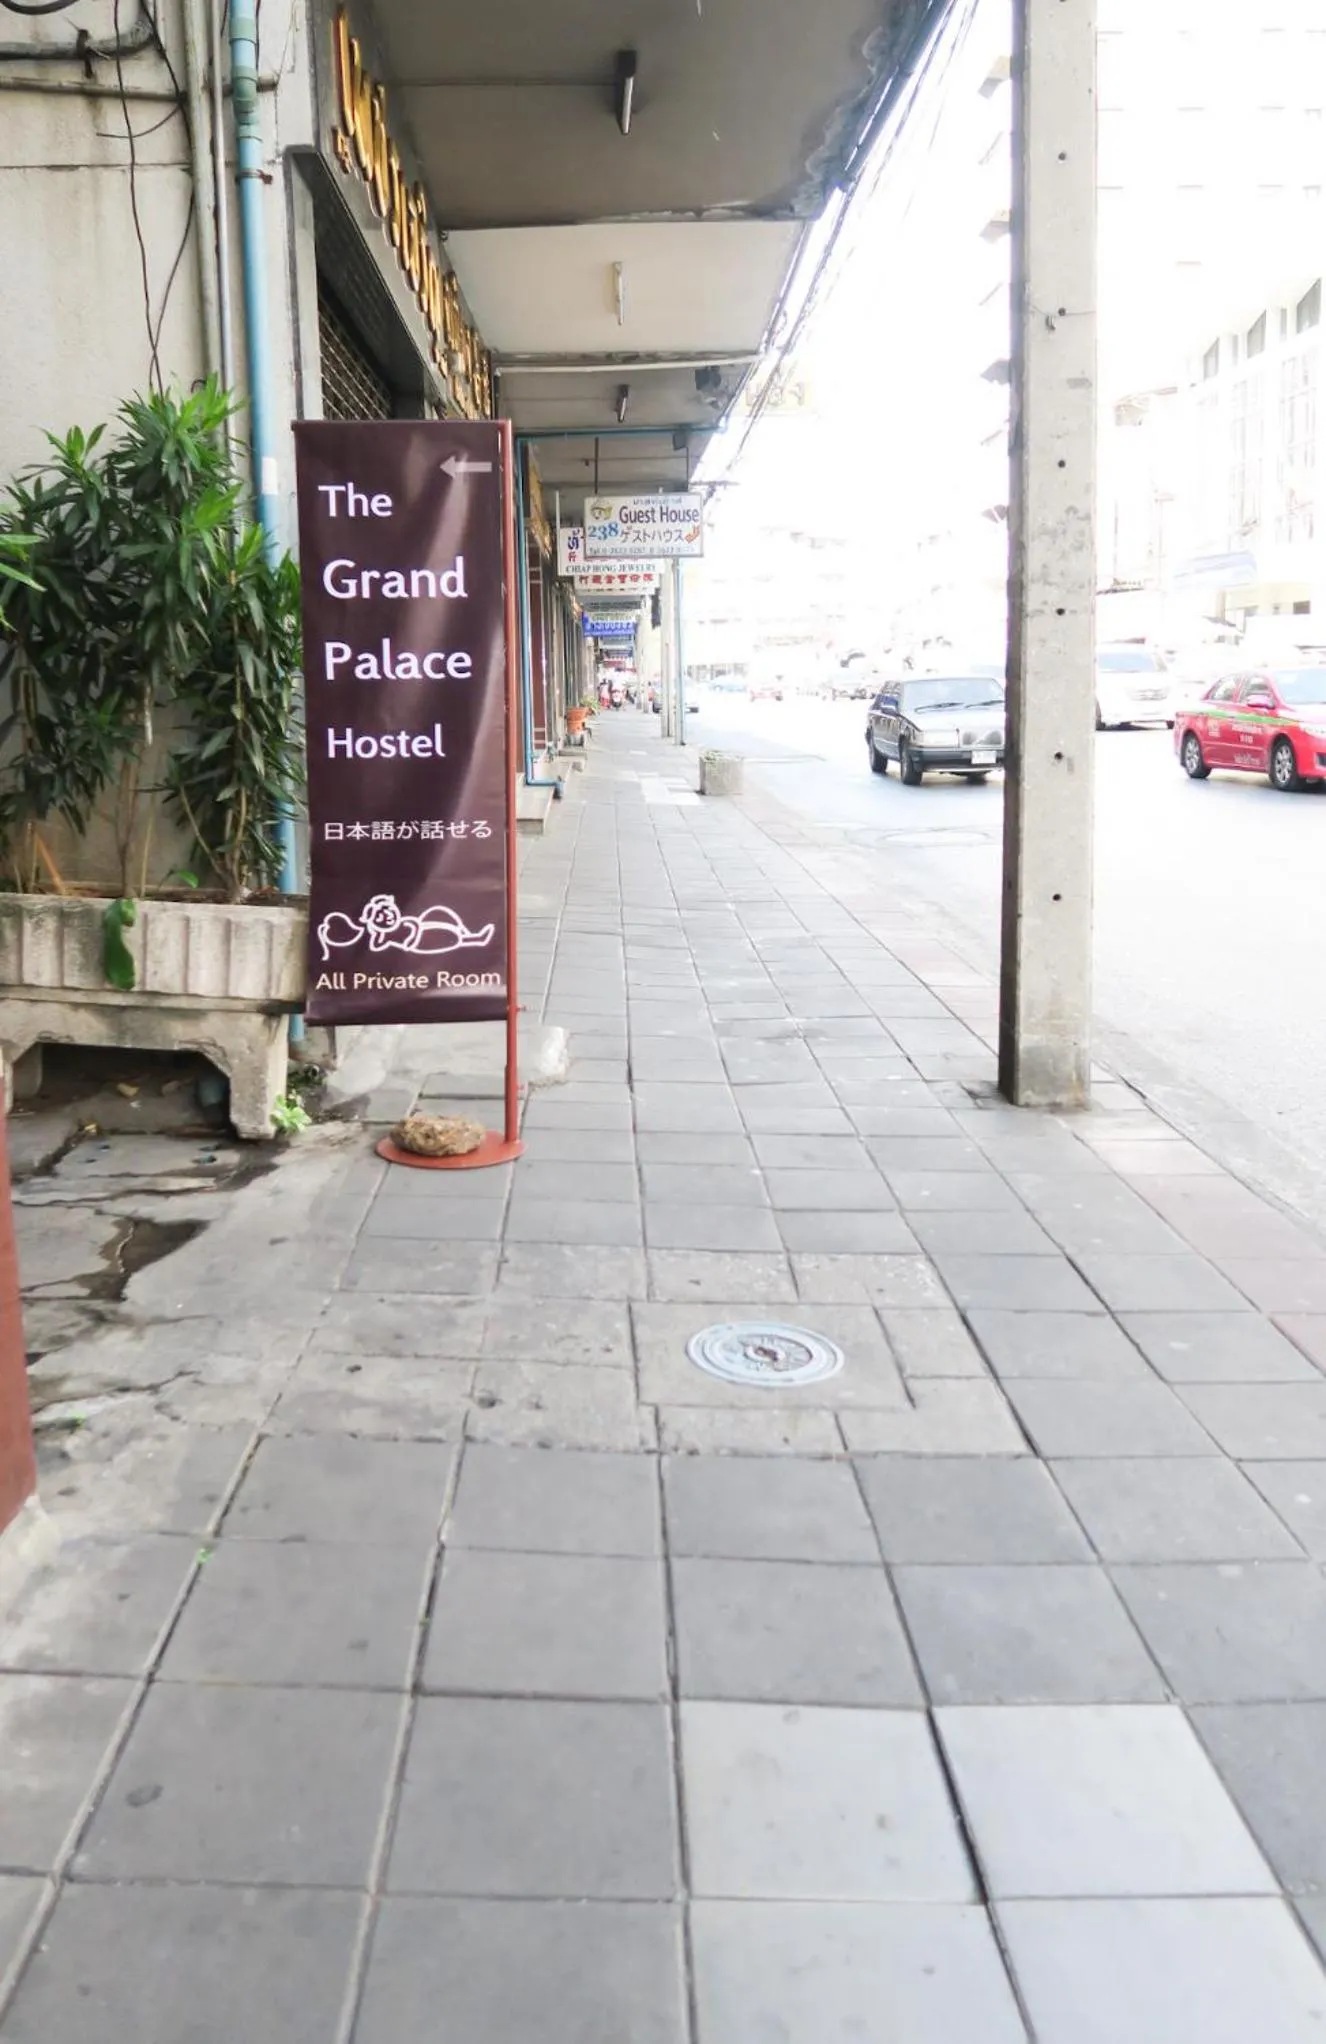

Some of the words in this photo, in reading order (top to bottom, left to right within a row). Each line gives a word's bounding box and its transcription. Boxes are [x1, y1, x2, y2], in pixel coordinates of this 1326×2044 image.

[318, 482, 393, 517] The
[619, 506, 656, 524] Guest
[660, 505, 699, 523] House
[588, 521, 619, 541] 238
[620, 526, 684, 543] ゲストハウス
[322, 555, 468, 599] Grand
[325, 638, 473, 682] Palace
[326, 723, 446, 759] Hostel
[324, 819, 493, 842] 日本語が話せる
[315, 972, 346, 990] All
[353, 972, 430, 990] Private
[437, 970, 501, 988] Room
